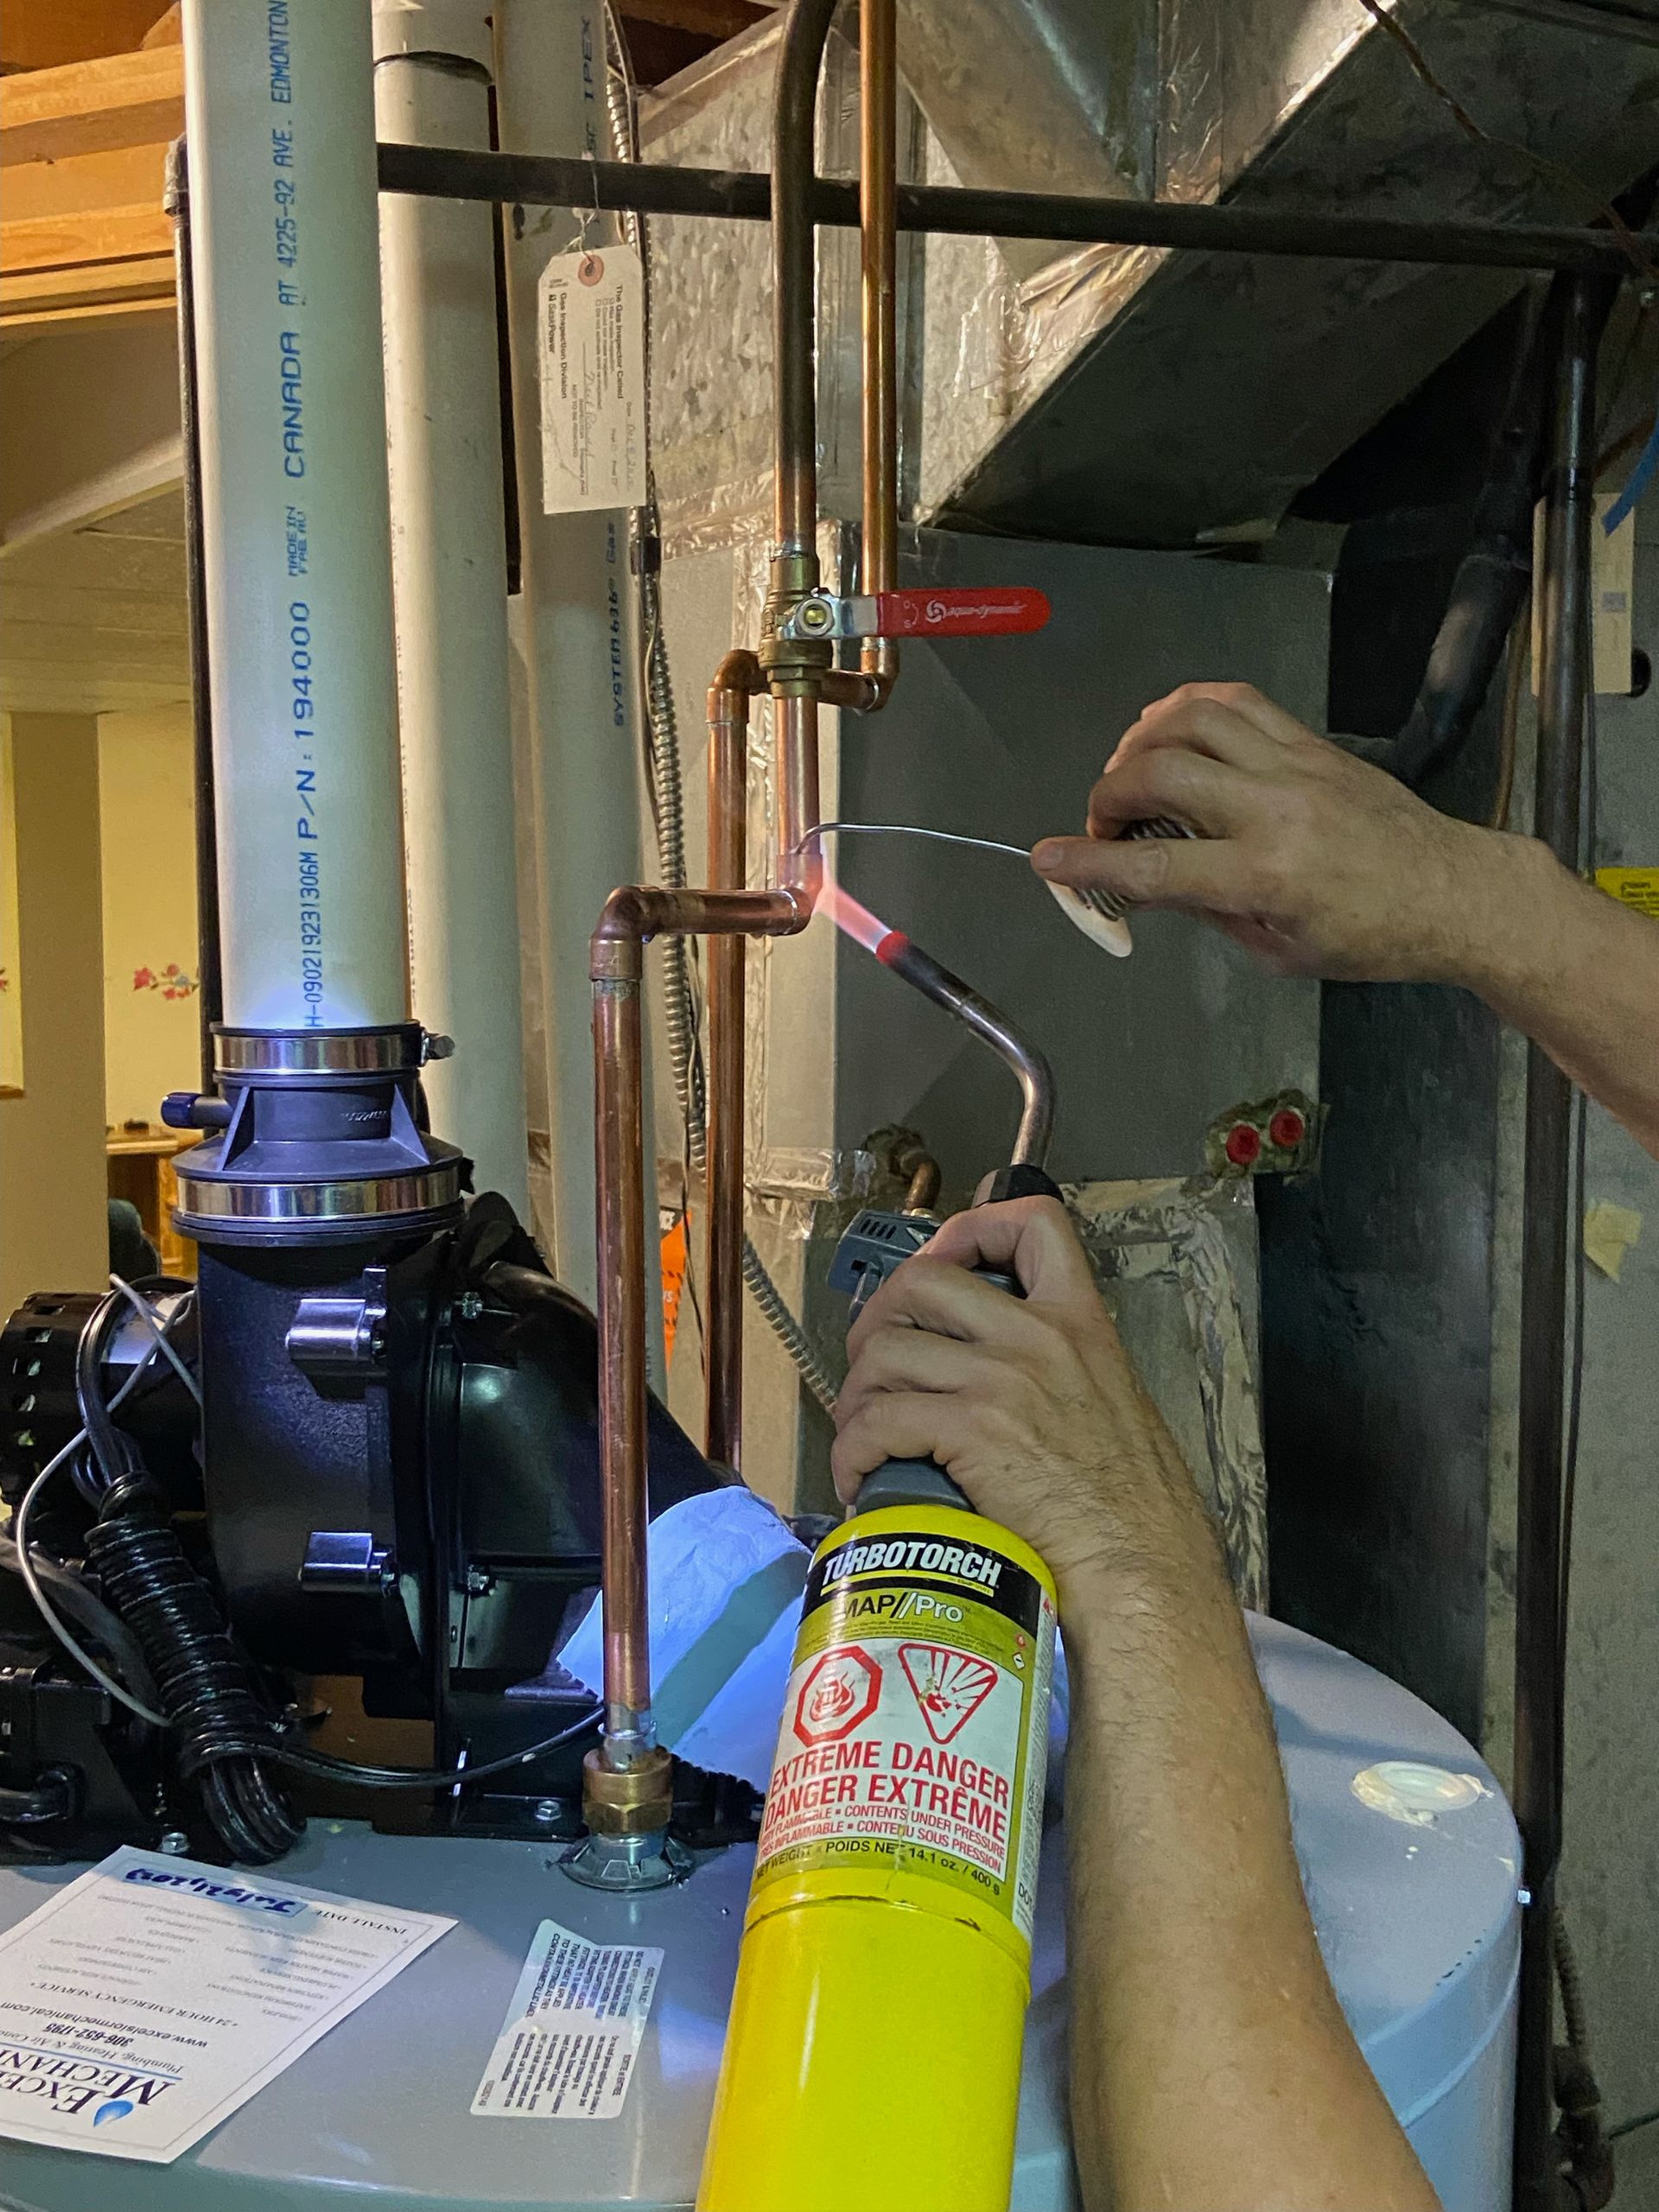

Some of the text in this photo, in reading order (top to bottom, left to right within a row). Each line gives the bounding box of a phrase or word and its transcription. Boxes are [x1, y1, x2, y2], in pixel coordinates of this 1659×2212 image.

[260, 0, 306, 479] CANADA AT 4225-92 AVE. EDMONTON
[286, 506, 296, 526] IN
[290, 602, 314, 739] 194000
[610, 639, 624, 728] SYSTEM
[296, 754, 318, 840] P/N:
[822, 1541, 1002, 1587] TURBOTORCH
[771, 1741, 1009, 1809] EXTREME DANGER
[765, 1774, 1007, 1844] DANGER EXTRÊME
[845, 1805, 908, 1821] CONTENTS
[911, 1810, 951, 1833] UNDER
[954, 1823, 1006, 1859] PRESSURE
[774, 1821, 844, 1850] INFLAMMABLE
[917, 1827, 950, 1848] SOUS
[951, 1838, 1001, 1874] PRESSION
[825, 1840, 870, 1853] POIDS
[909, 1847, 936, 1864] 14.1
[941, 1858, 960, 1872] oz.
[962, 1865, 969, 1875] /
[971, 1869, 992, 1888] 400
[994, 1884, 1001, 1896] g
[223, 1888, 296, 1913] July
[315, 1909, 408, 1936] INSTALL DATE
[561, 1938, 570, 1948] TO
[568, 1942, 580, 1958] THAT
[41, 1982, 92, 2001] SERVICE
[99, 1992, 175, 2017] EMERGENCY
[0, 2001, 208, 2049] www.excelsiormechanical.com
[175, 2009, 214, 2025] HOUR
[30, 2035, 50, 2047] Air
[44, 2021, 136, 2048] 306-652-1795
[54, 2040, 67, 2049] &
[120, 2050, 185, 2075] Plumbing,
